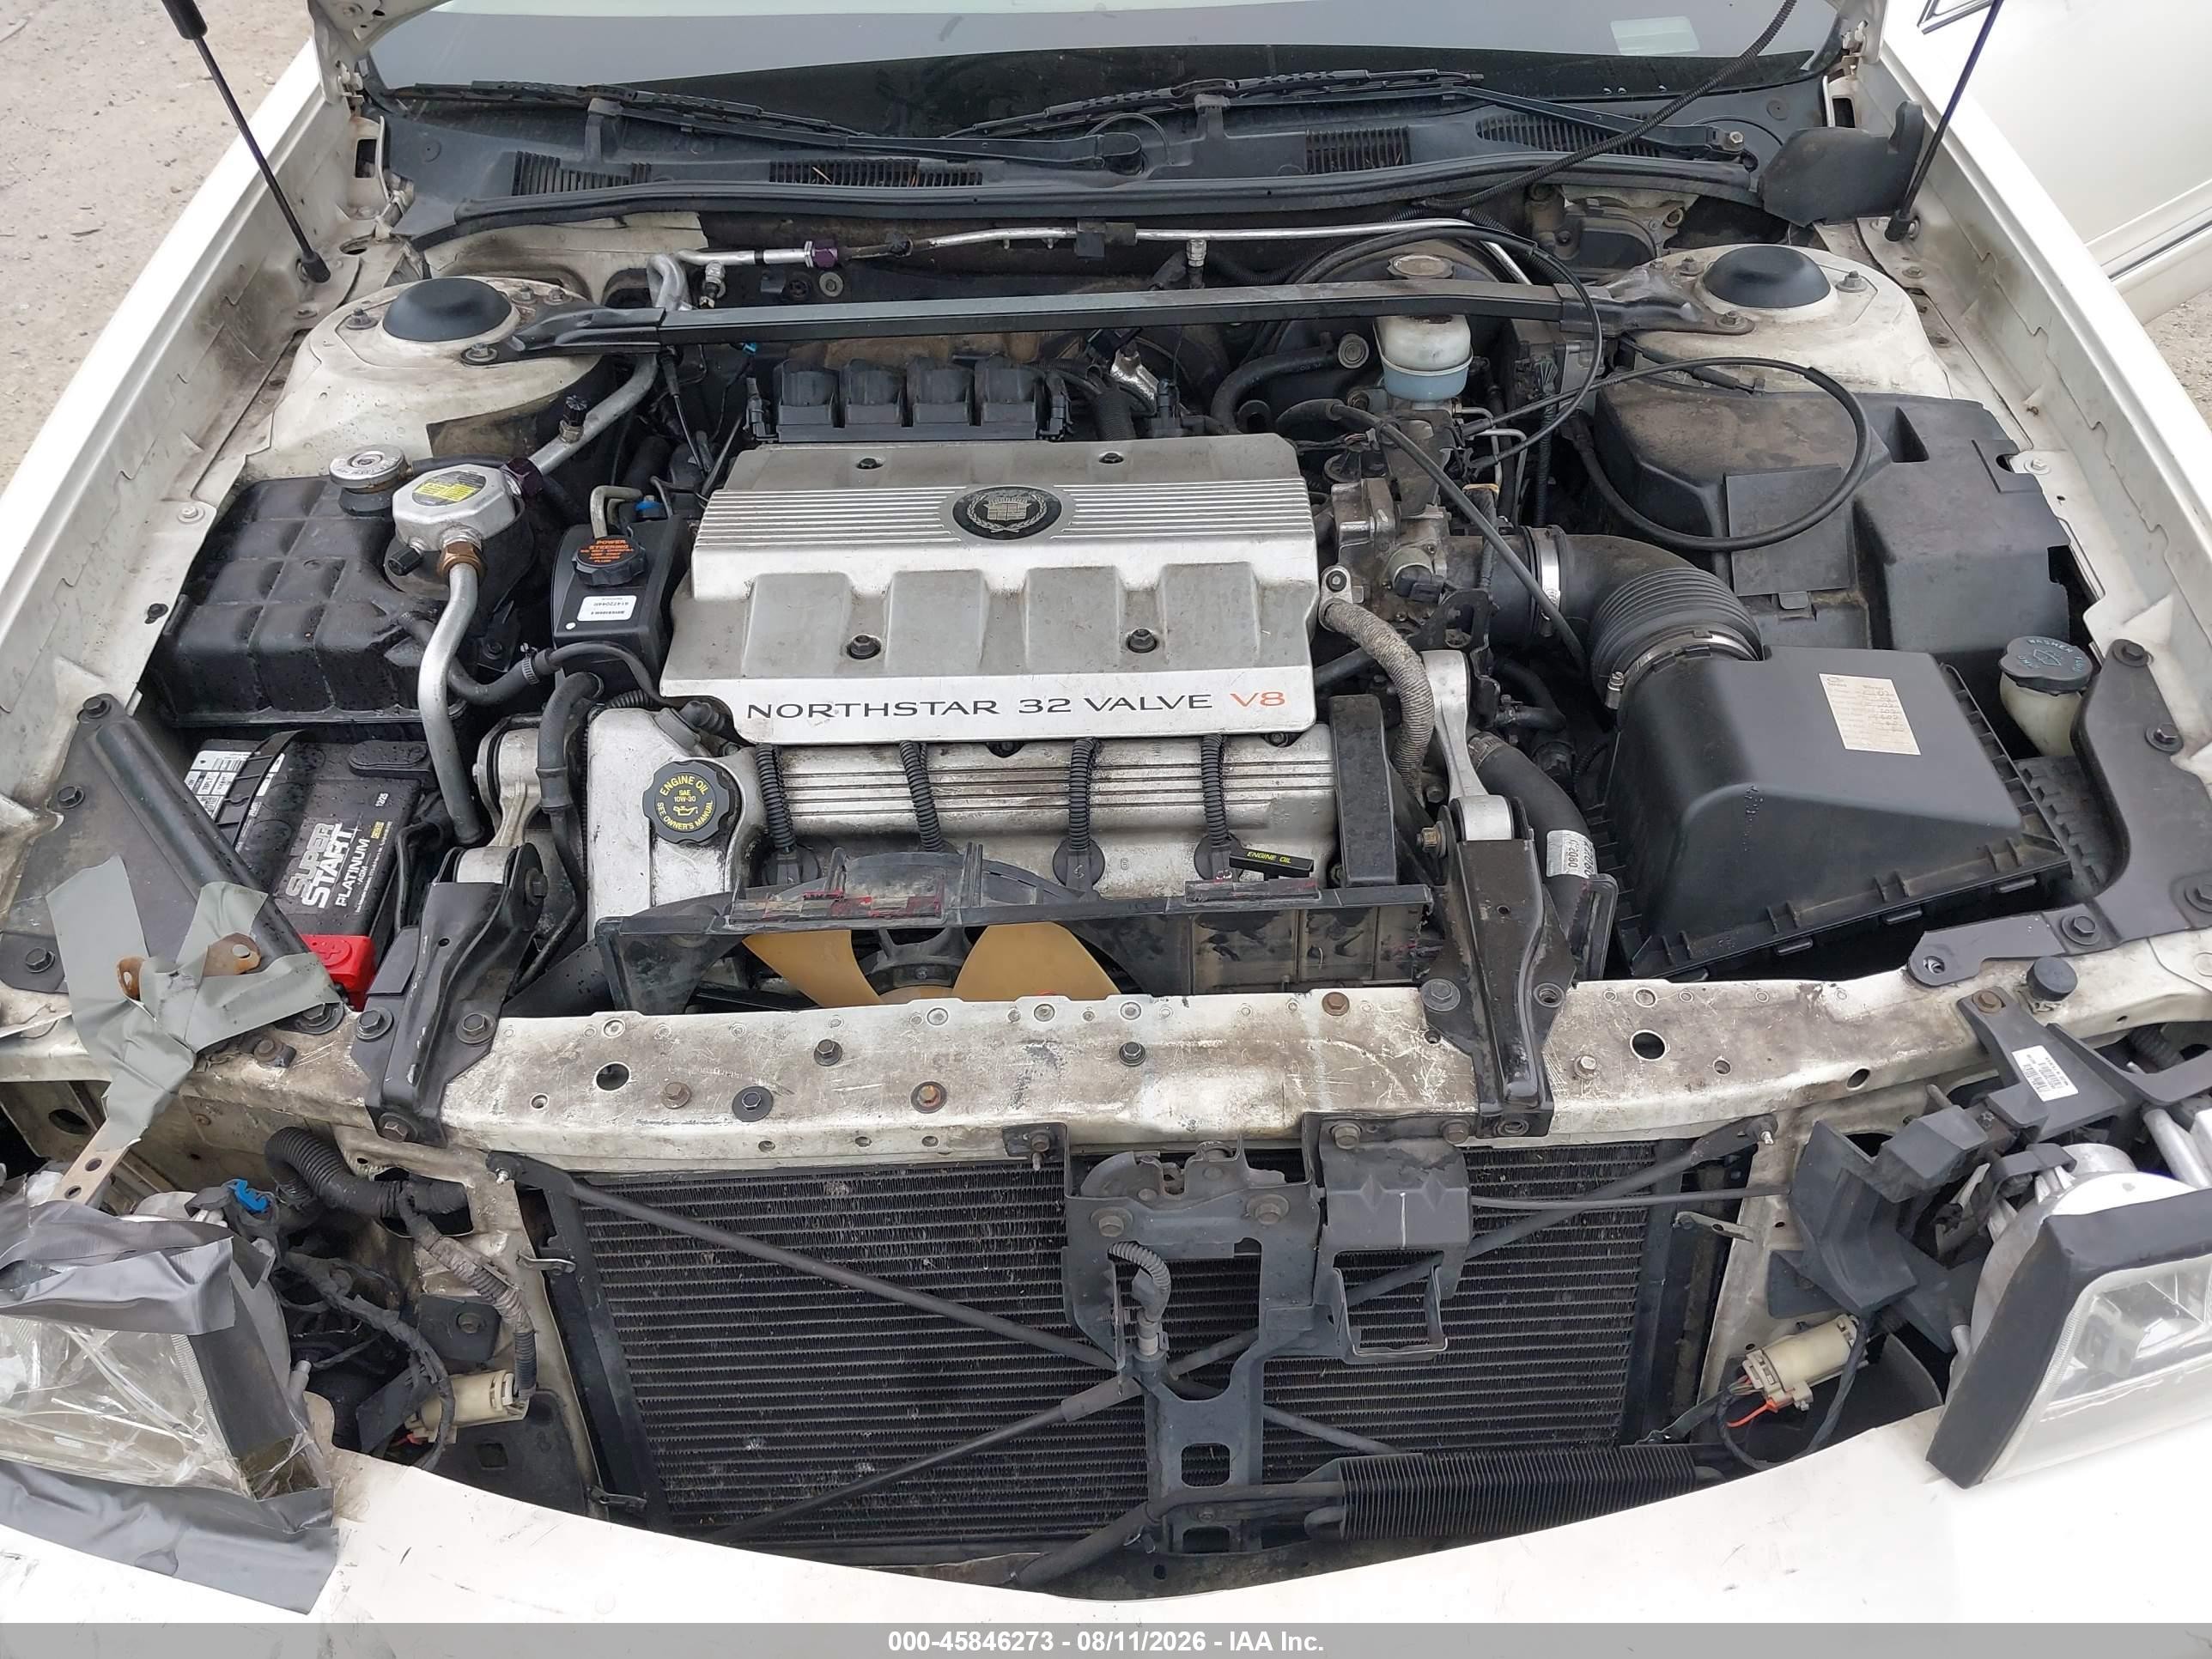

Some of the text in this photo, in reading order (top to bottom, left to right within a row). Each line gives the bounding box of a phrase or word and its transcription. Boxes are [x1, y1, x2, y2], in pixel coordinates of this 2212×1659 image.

[747, 691, 1286, 719] NORTHSTAR 32 VALVE V8
[375, 792, 389, 807] 12/25
[659, 775, 708, 796] ENGINE OIL
[657, 800, 714, 830] SEE OWNER'S MANUAL
[286, 823, 335, 896] SUPER
[301, 822, 353, 908] START
[1247, 851, 1277, 861] ENGINE
[335, 838, 371, 907] PLATINUM
[357, 866, 368, 884] AGM
